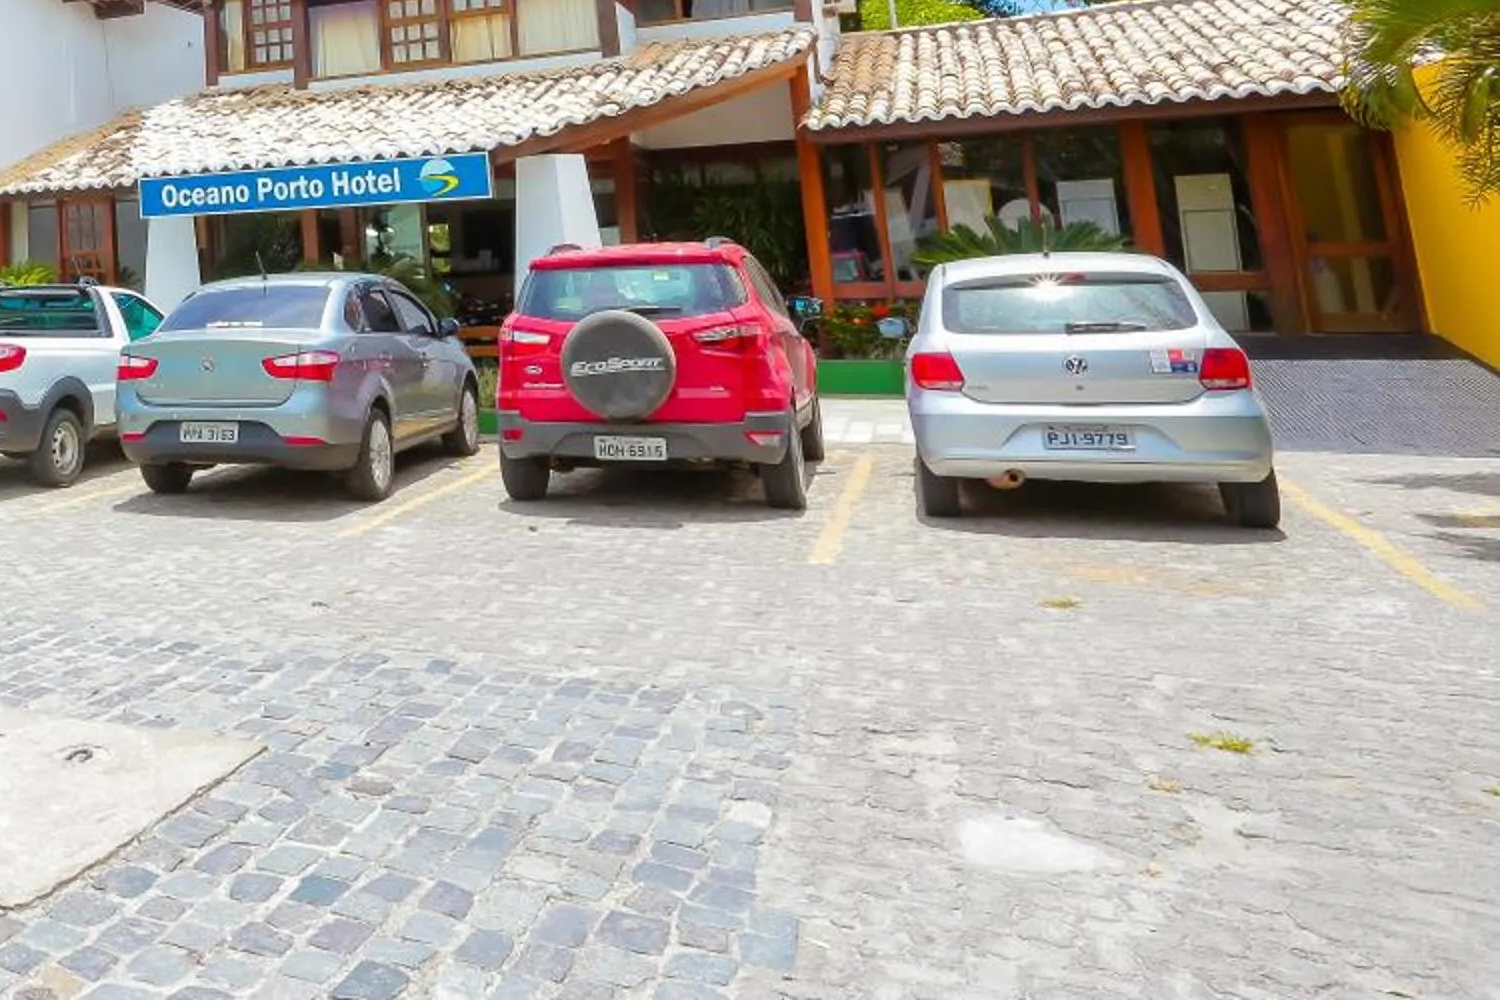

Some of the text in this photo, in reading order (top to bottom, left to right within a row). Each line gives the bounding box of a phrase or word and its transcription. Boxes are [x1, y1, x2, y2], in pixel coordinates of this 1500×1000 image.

[161, 167, 401, 207] Oceano Porto Hotel
